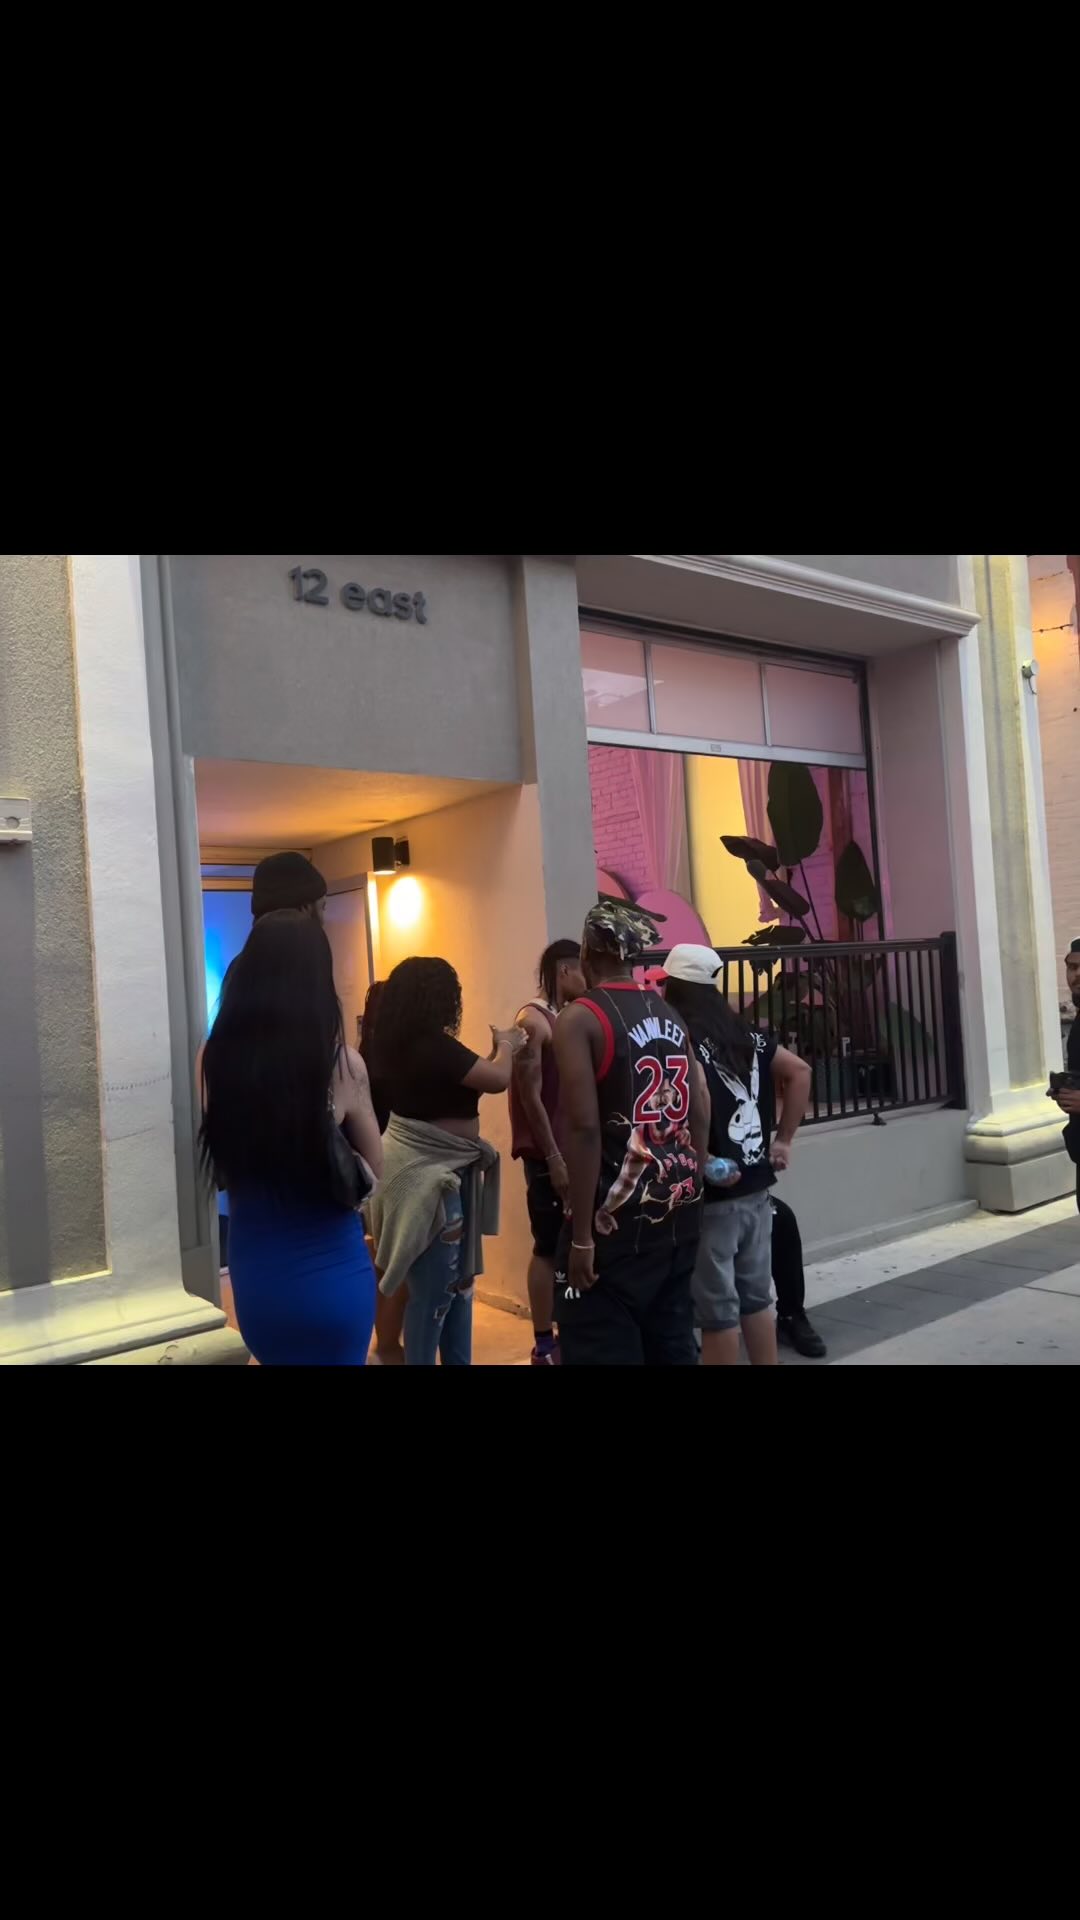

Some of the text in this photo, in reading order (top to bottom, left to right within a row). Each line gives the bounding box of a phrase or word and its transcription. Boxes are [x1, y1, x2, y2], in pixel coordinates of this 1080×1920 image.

[288, 566, 428, 625] 12 east
[633, 1055, 689, 1123] 23
[669, 1177, 695, 1206] 23
